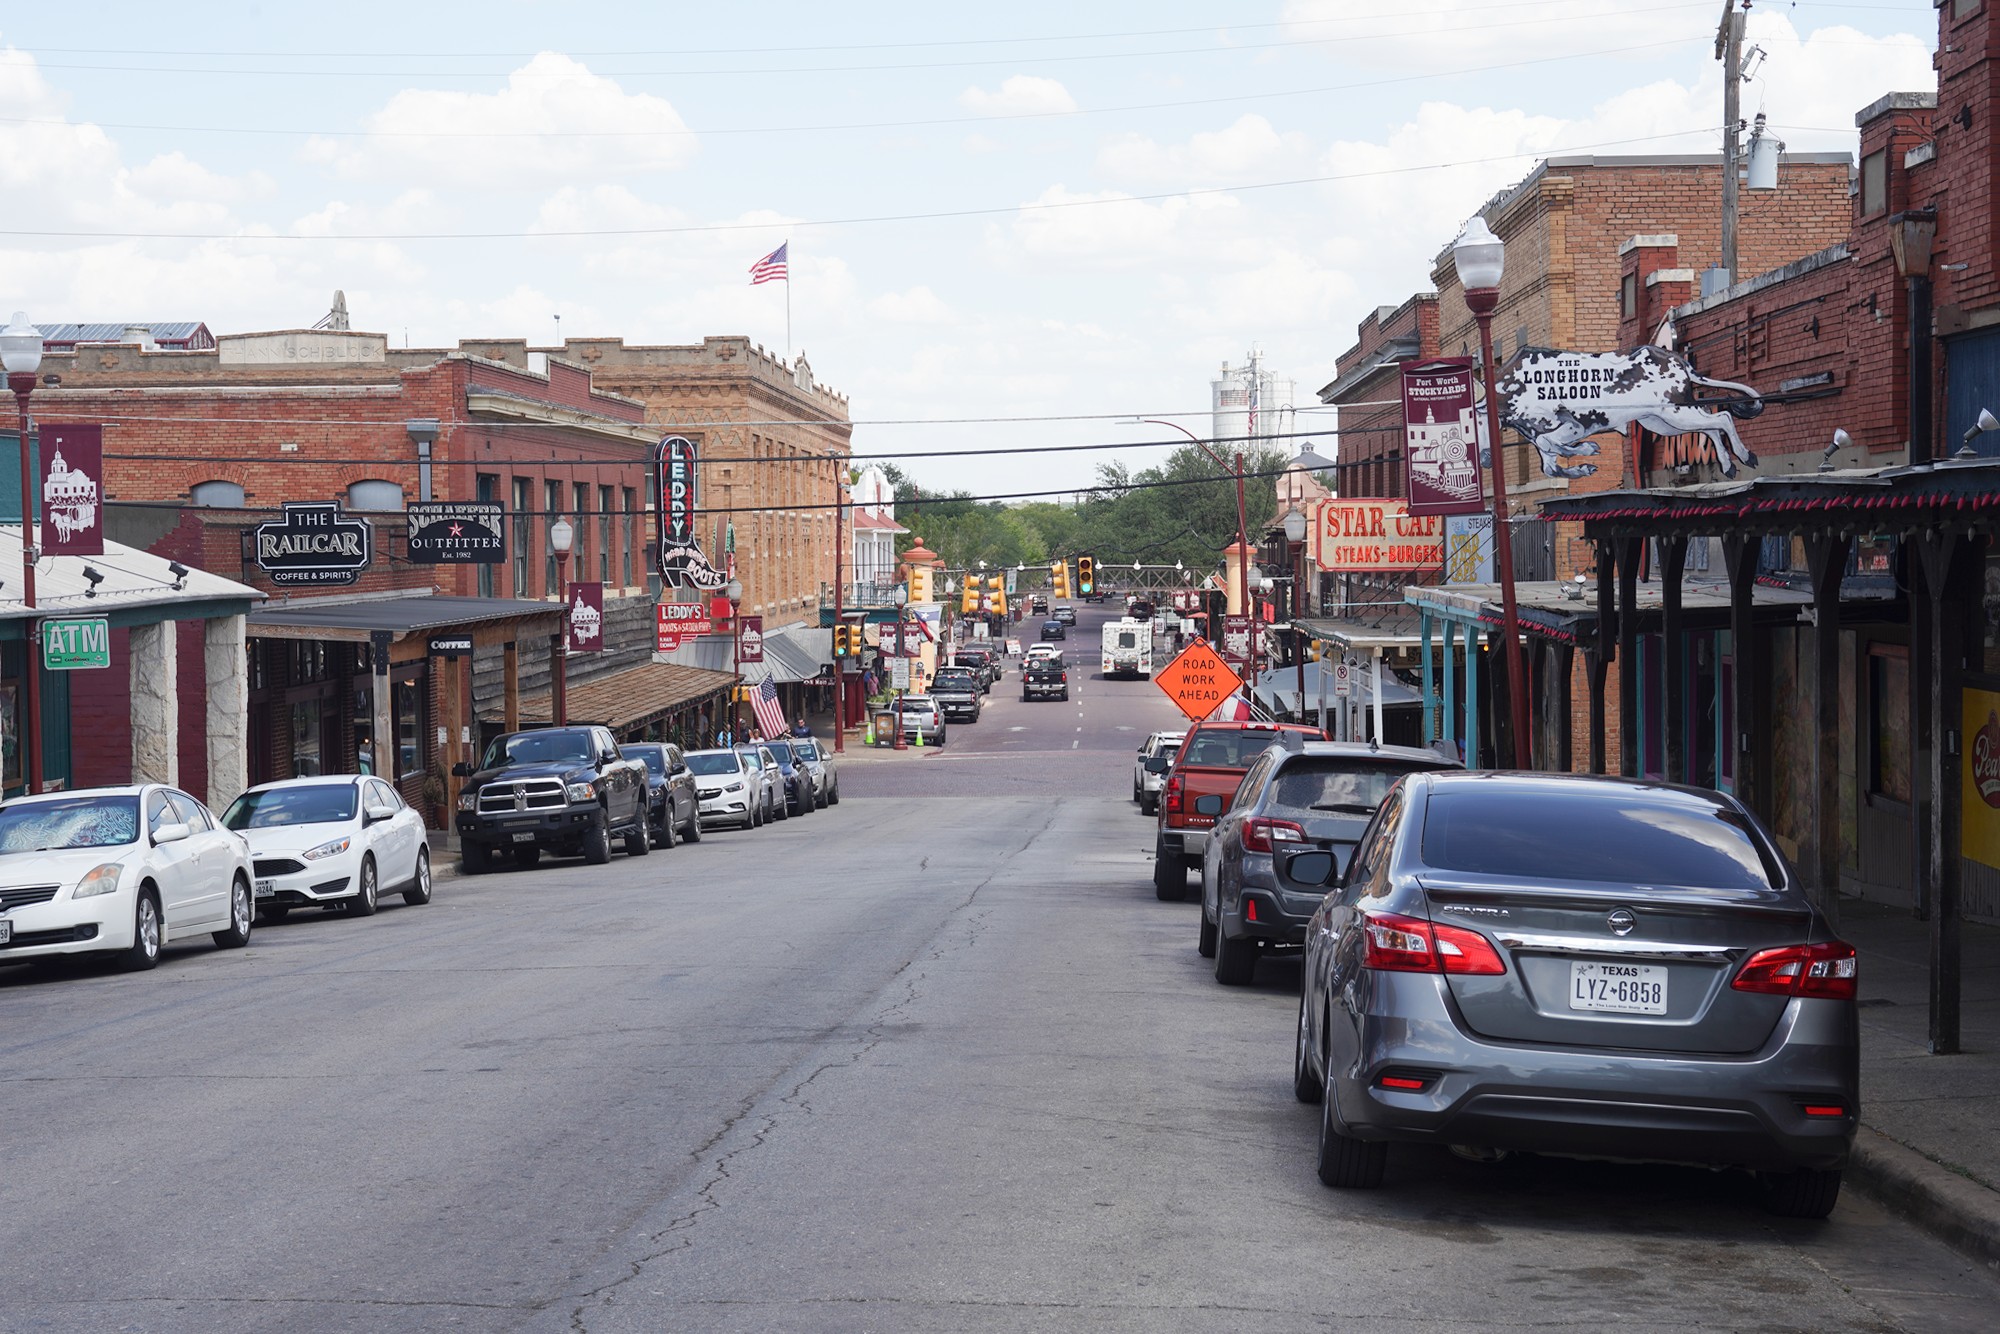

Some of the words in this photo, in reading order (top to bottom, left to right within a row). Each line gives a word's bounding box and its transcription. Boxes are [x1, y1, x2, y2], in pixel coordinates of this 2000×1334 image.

[325, 346, 382, 358] BLOCK
[1436, 376, 1459, 385] Worth
[1523, 368, 1616, 384] LONGHORN
[1408, 384, 1467, 396] STOCKYARDS
[1537, 385, 1601, 400] SALOON
[671, 444, 687, 537] LEDDY
[296, 513, 328, 526] THE
[1327, 506, 1386, 538] STAR
[1396, 507, 1443, 537] CAF
[1468, 517, 1492, 529] STEAKS
[260, 532, 362, 558] RAILCAR
[412, 538, 501, 548] OUTFITTER
[275, 572, 309, 580] COFFEE
[312, 572, 317, 580] &
[320, 572, 352, 580] SPIRITS
[687, 559, 721, 586] BOOTS
[662, 605, 702, 620] LEDDY'S
[659, 623, 677, 633] BOOTS
[48, 624, 106, 654] ATM
[1183, 659, 1215, 669] ROAD
[1182, 675, 1215, 685] WORK
[1178, 690, 1219, 700] AHEAD
[1443, 906, 1510, 918] SENTRA
[1601, 966, 1638, 977] TEXAS
